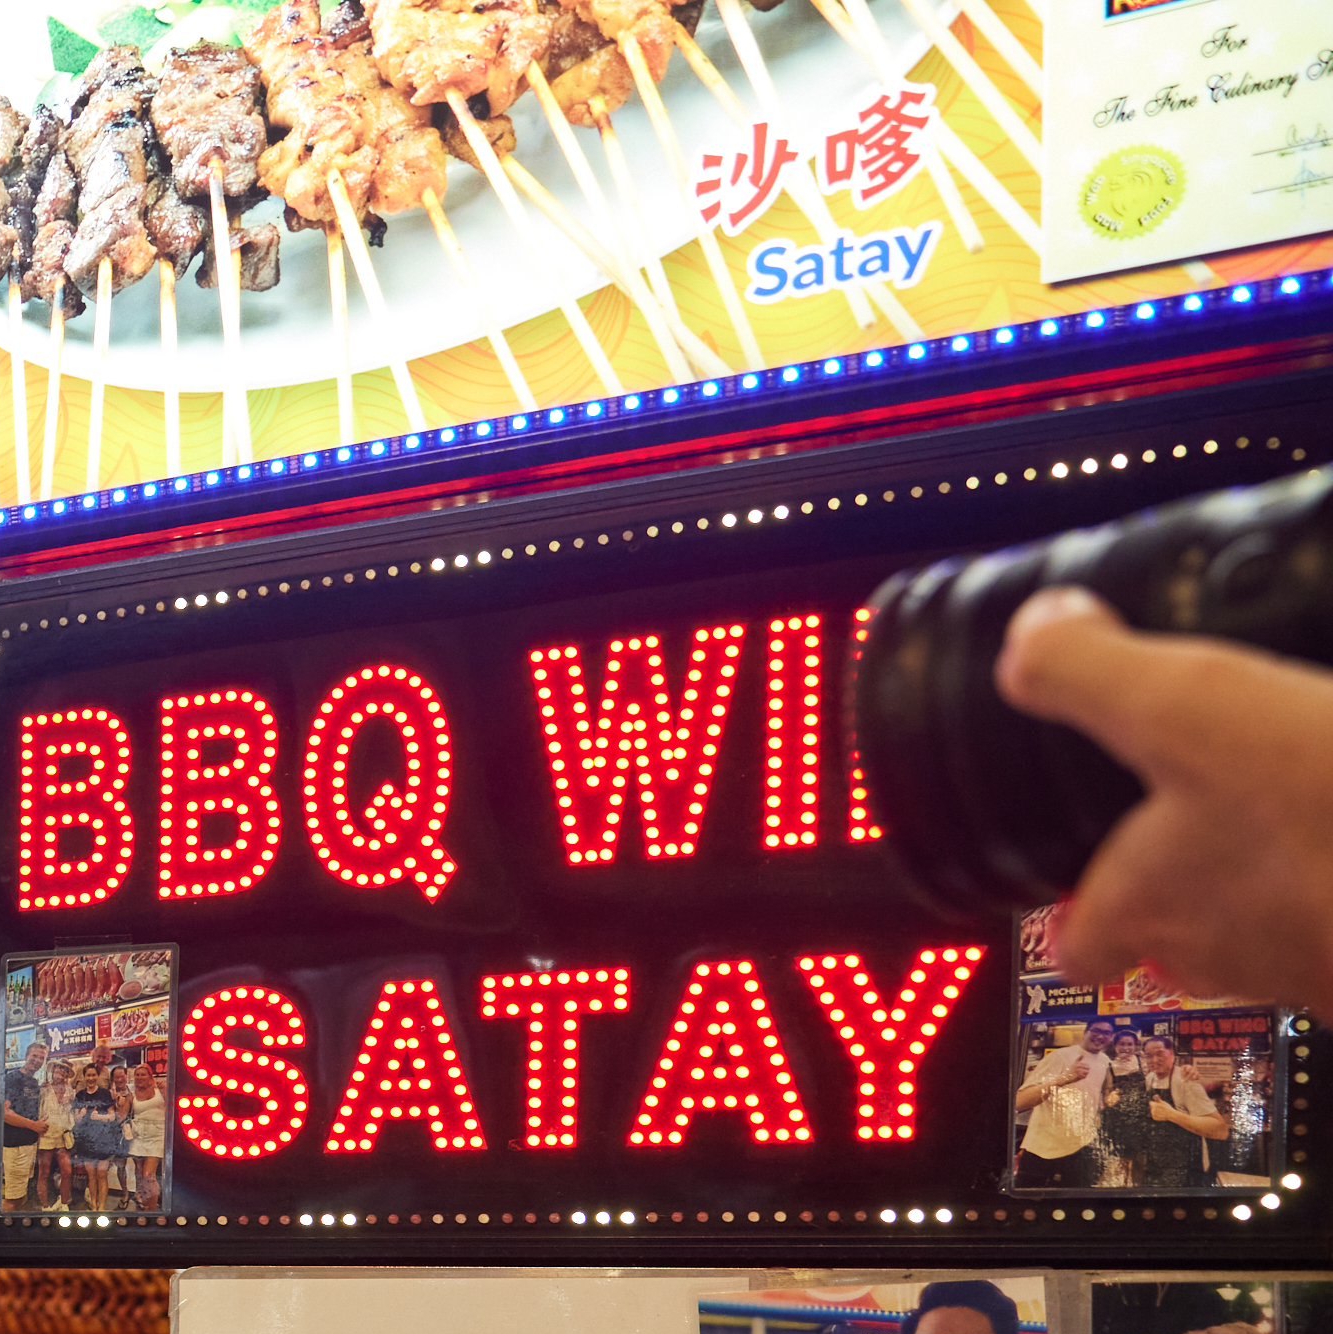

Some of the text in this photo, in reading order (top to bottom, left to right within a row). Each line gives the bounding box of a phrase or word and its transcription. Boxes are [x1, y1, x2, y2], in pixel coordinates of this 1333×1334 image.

[1201, 24, 1248, 58] For
[1093, 72, 1298, 128] The Fine Culinary
[695, 90, 930, 229] 沙嗲
[1120, 153, 1177, 186] Singapore
[1138, 196, 1173, 228] Food
[753, 229, 933, 297] Satay
[17, 608, 885, 913] BBQ WI
[1048, 984, 1093, 998] MICHELIN
[63, 1026, 93, 1037] MICHELIN
[1179, 1017, 1266, 1034] BBQ WING
[178, 945, 987, 1161] SATAY
[1191, 1036, 1251, 1051] SATAY
